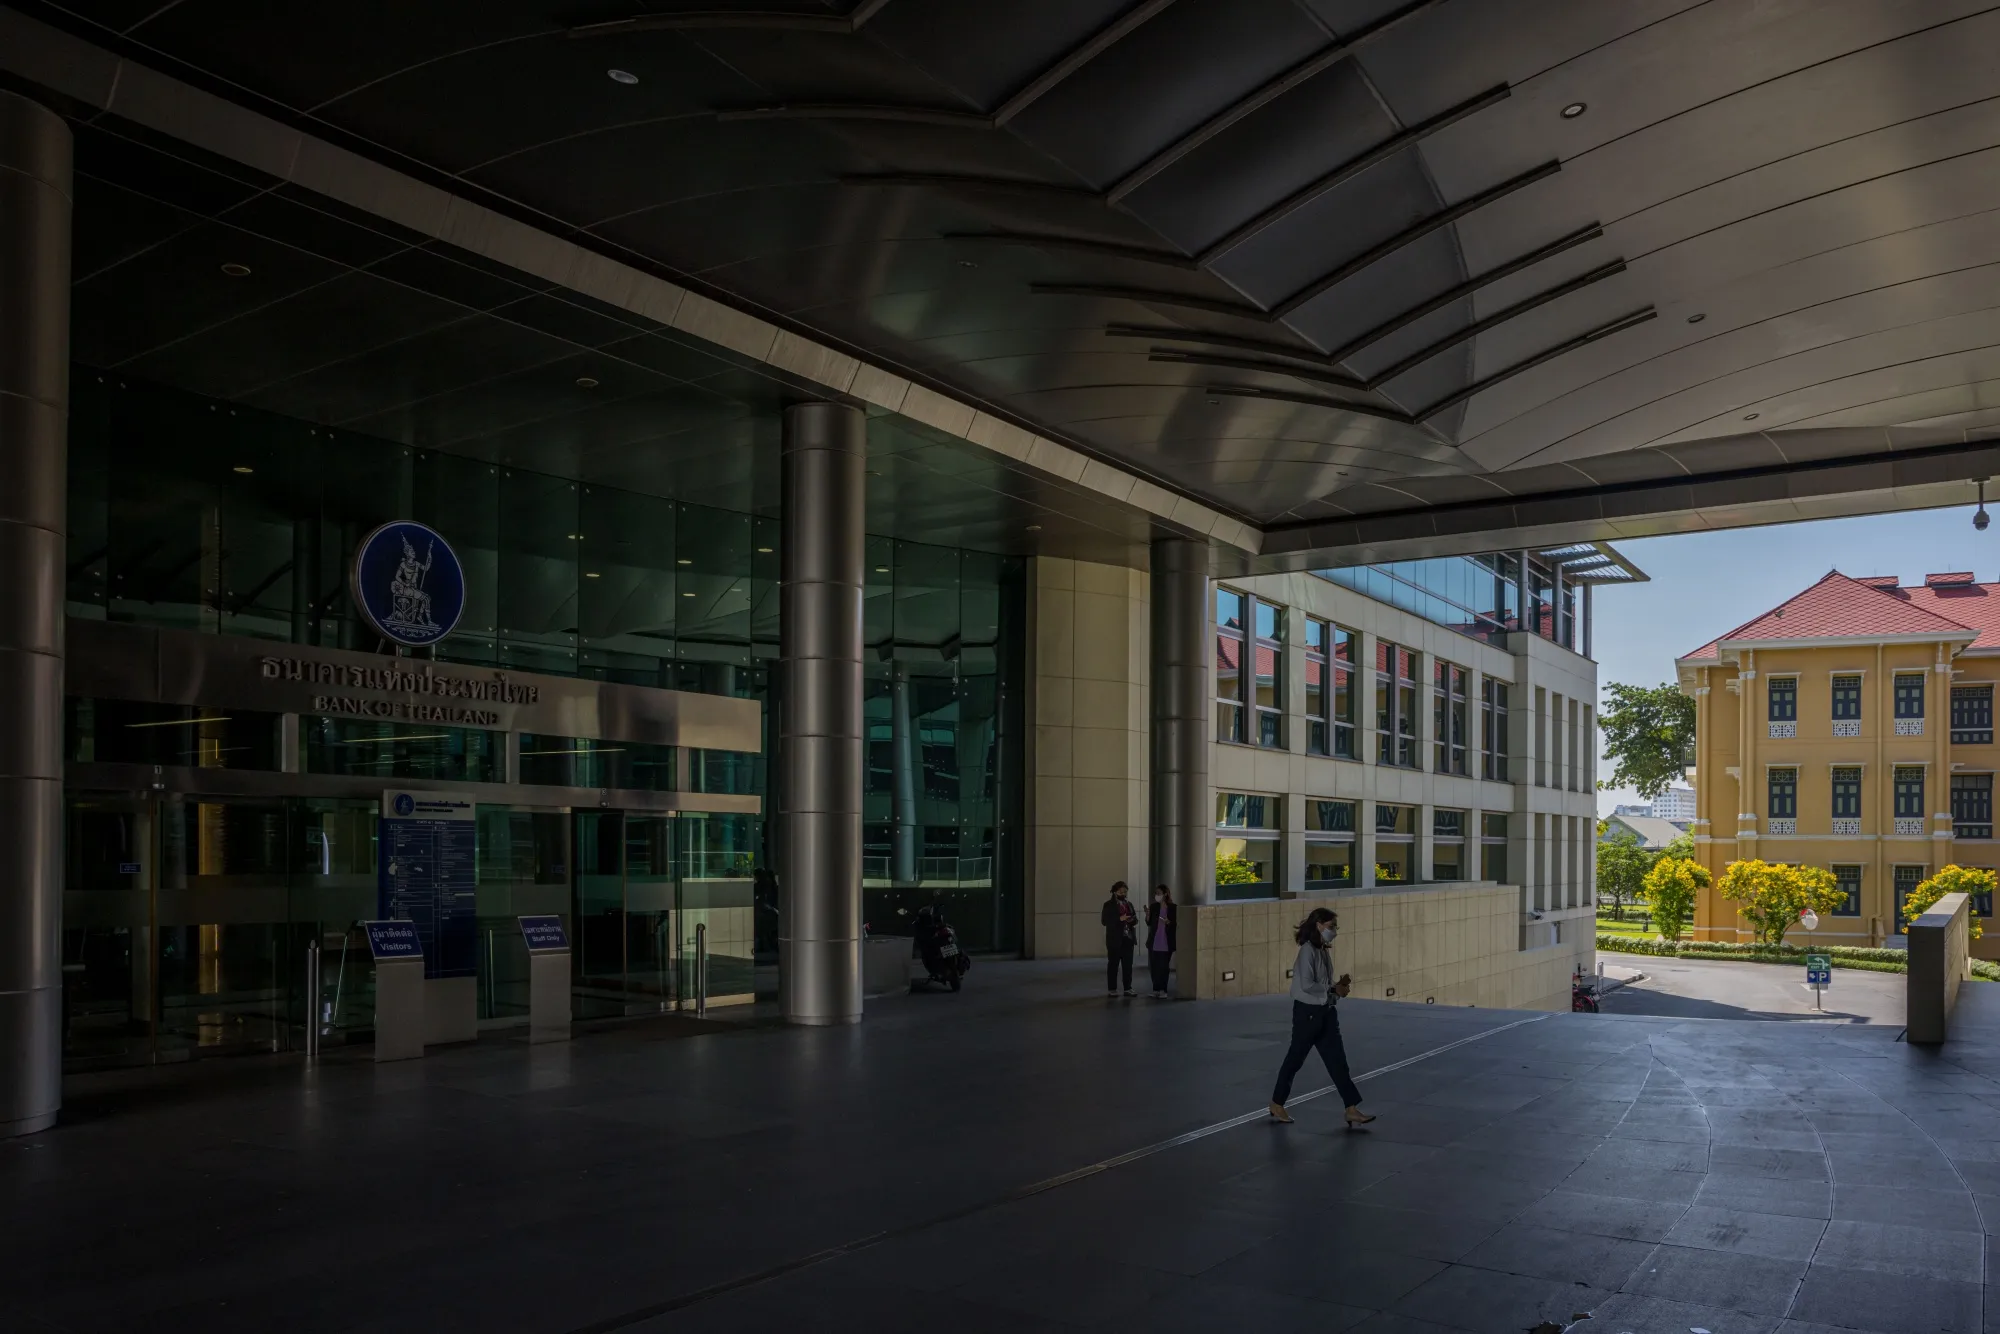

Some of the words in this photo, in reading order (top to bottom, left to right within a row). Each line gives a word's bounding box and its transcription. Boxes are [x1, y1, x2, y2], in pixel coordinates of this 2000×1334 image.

[261, 656, 541, 704] ธนาคารแห่งประเทศไทย
[313, 695, 373, 716] BANK
[374, 700, 401, 717] OF
[372, 927, 413, 942] ผู้มาติดต่อ
[546, 934, 560, 942] Only
[380, 943, 412, 951] Visitors
[1819, 972, 1828, 982] P
